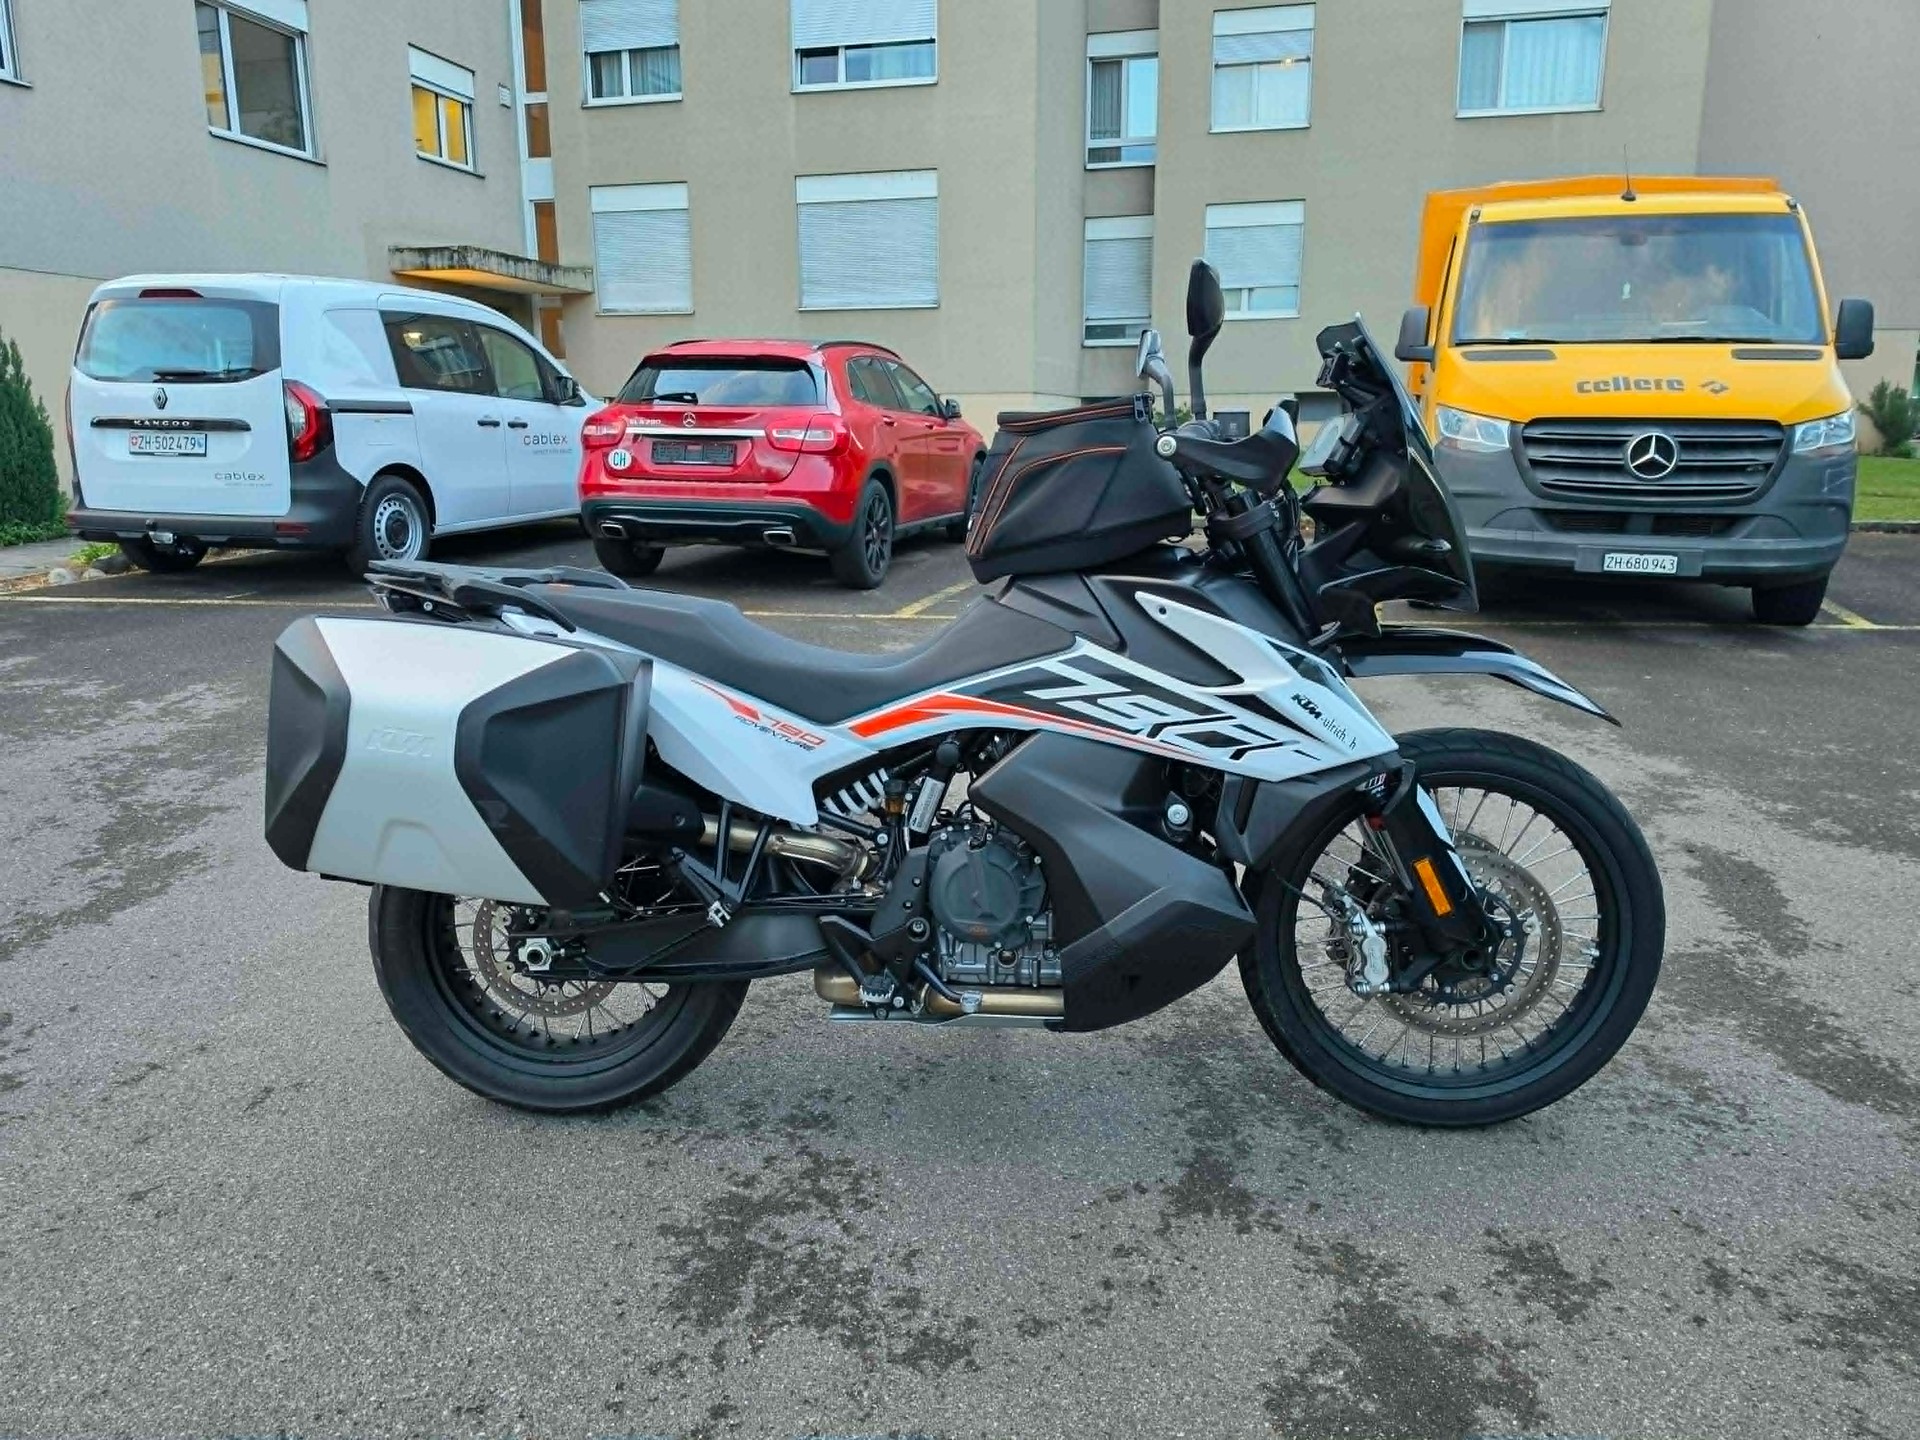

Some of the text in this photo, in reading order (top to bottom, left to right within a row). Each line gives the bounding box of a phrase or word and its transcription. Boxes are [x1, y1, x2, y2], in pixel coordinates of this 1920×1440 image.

[1576, 376, 1685, 393] cellere
[523, 432, 568, 446] cablex
[613, 451, 626, 467] CH
[214, 471, 266, 481] cablex
